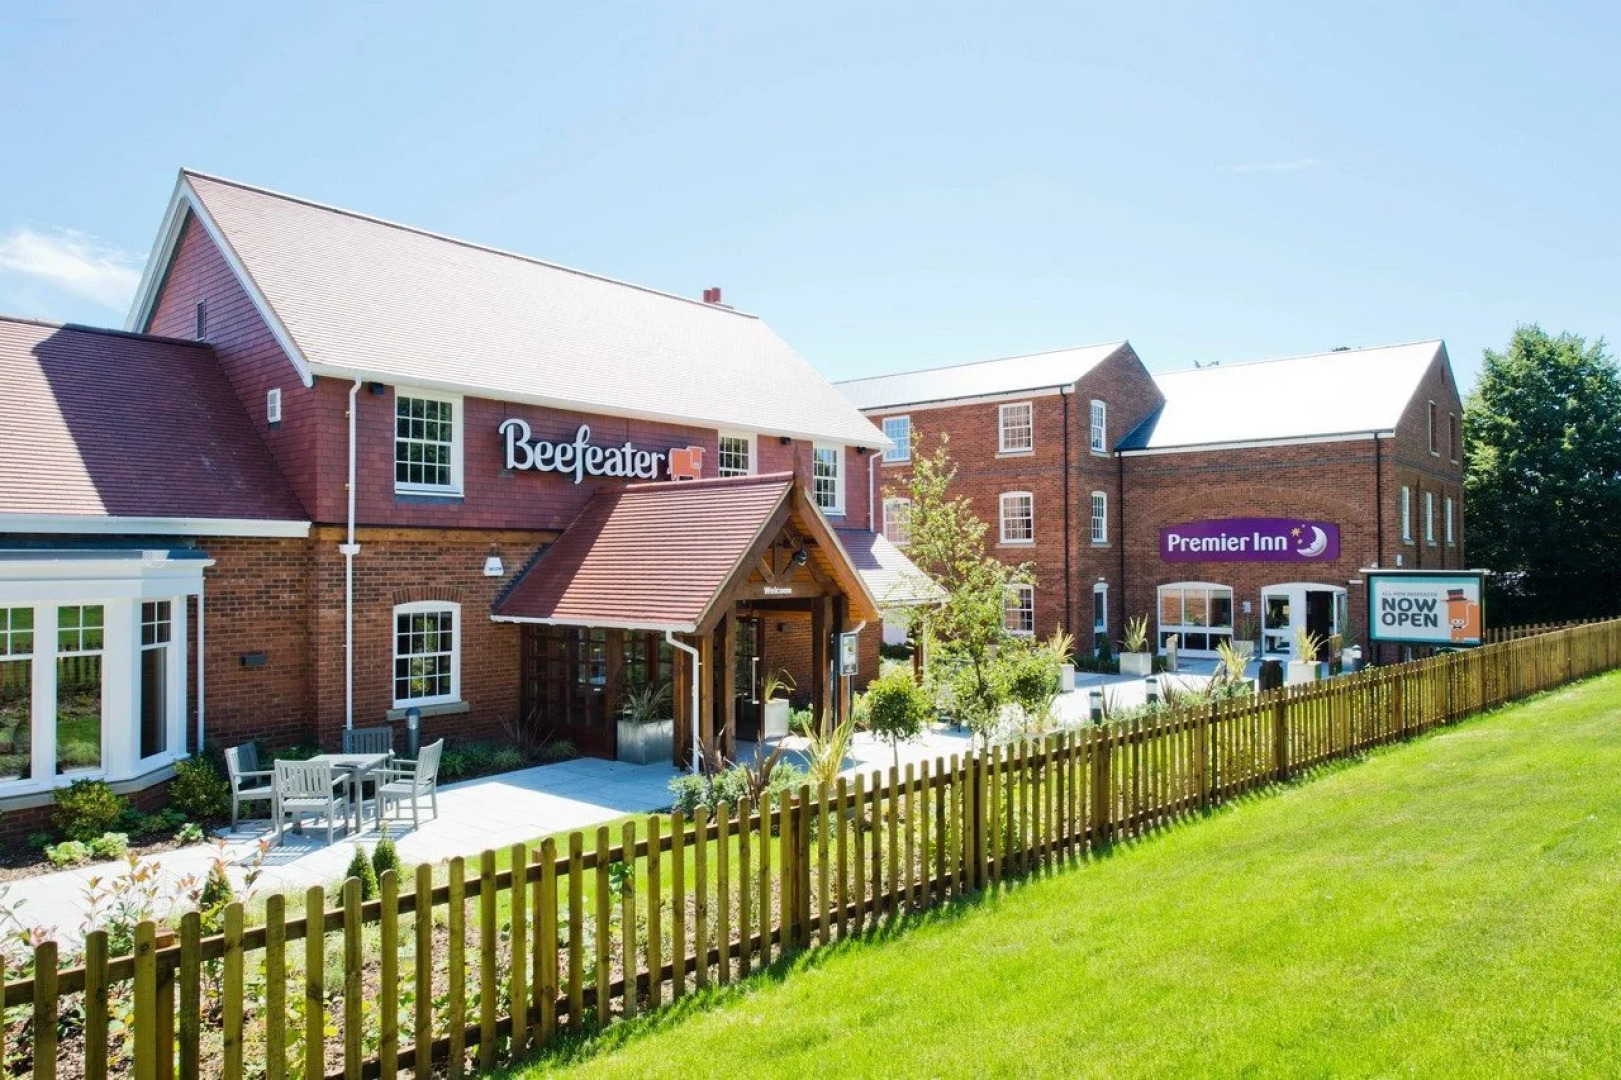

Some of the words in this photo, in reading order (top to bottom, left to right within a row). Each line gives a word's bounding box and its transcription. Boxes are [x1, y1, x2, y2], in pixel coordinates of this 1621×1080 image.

[499, 418, 665, 484] Beefeater
[1168, 533, 1250, 552] Premier
[1254, 532, 1288, 551] Inn
[764, 586, 792, 595] Welcome
[1382, 597, 1437, 613] NOW
[1382, 612, 1438, 628] OPEN
